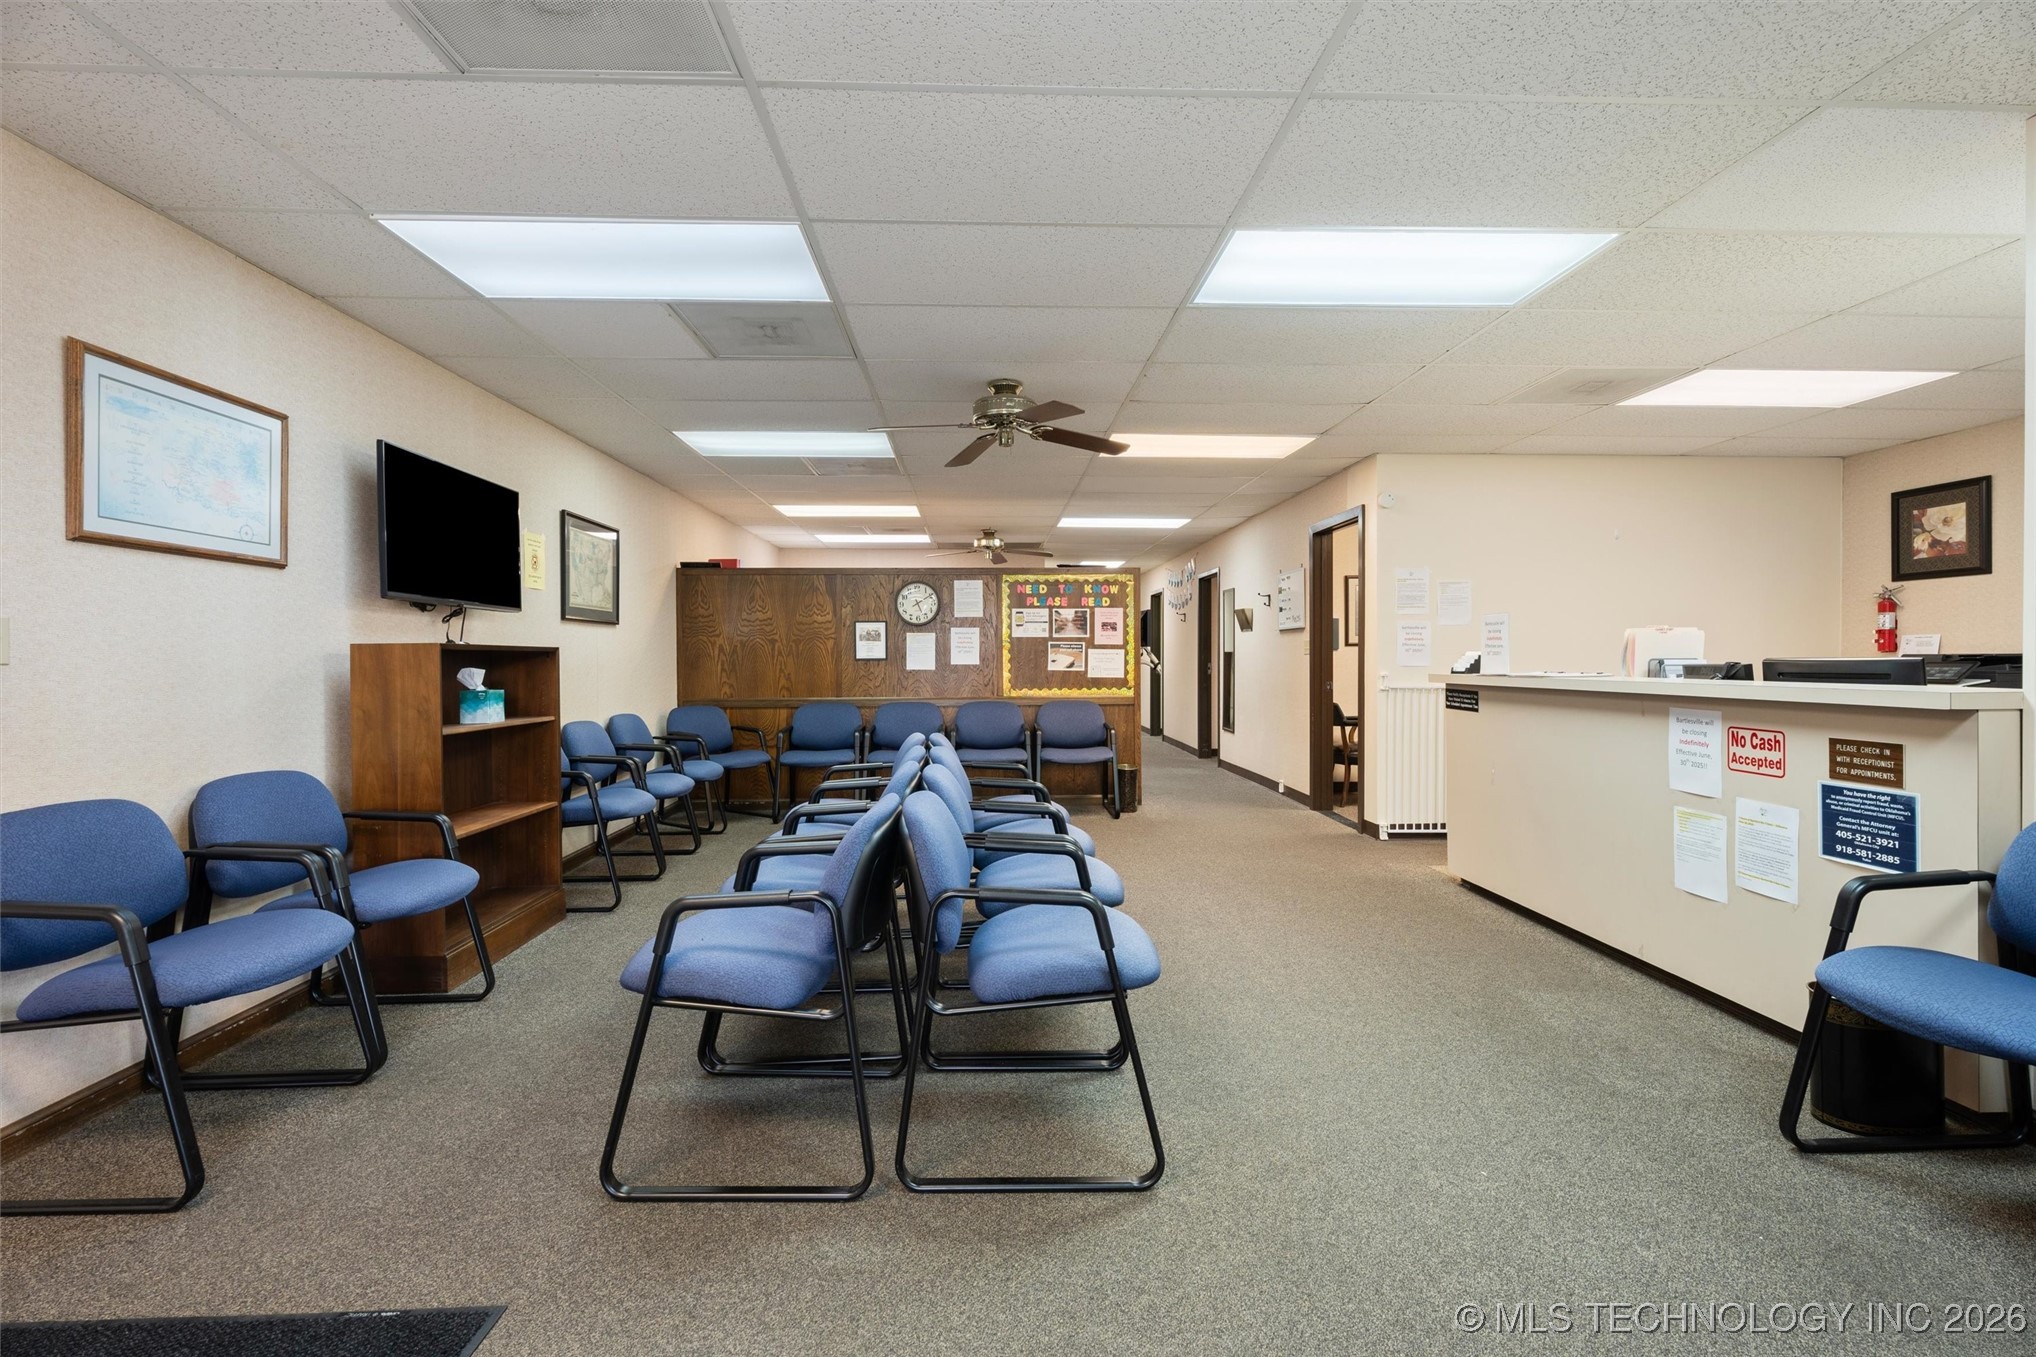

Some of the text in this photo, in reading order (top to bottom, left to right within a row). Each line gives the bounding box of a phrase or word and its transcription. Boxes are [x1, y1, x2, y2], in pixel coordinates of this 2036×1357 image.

[1017, 584, 1119, 594] NEED TO KNOW
[1026, 597, 1110, 606] PLEASE READ
[1690, 729, 1708, 738] closing
[1731, 730, 1781, 752] No Cash
[1676, 748, 1698, 756] Effective
[1836, 744, 1858, 752] PLEASE
[1860, 746, 1880, 754] CHECK
[1731, 752, 1782, 770] Accepted
[1853, 757, 1894, 768] RECEPTIONIST
[1850, 768, 1896, 780] APPOINTMENTS.
[1836, 822, 1860, 830] General's
[1861, 826, 1878, 834] MFCU
[1838, 816, 1860, 824] Contact
[1870, 821, 1896, 831] Attorney
[1835, 830, 1899, 848] 405-521-3921
[1836, 844, 1900, 864] 918-581-2885
